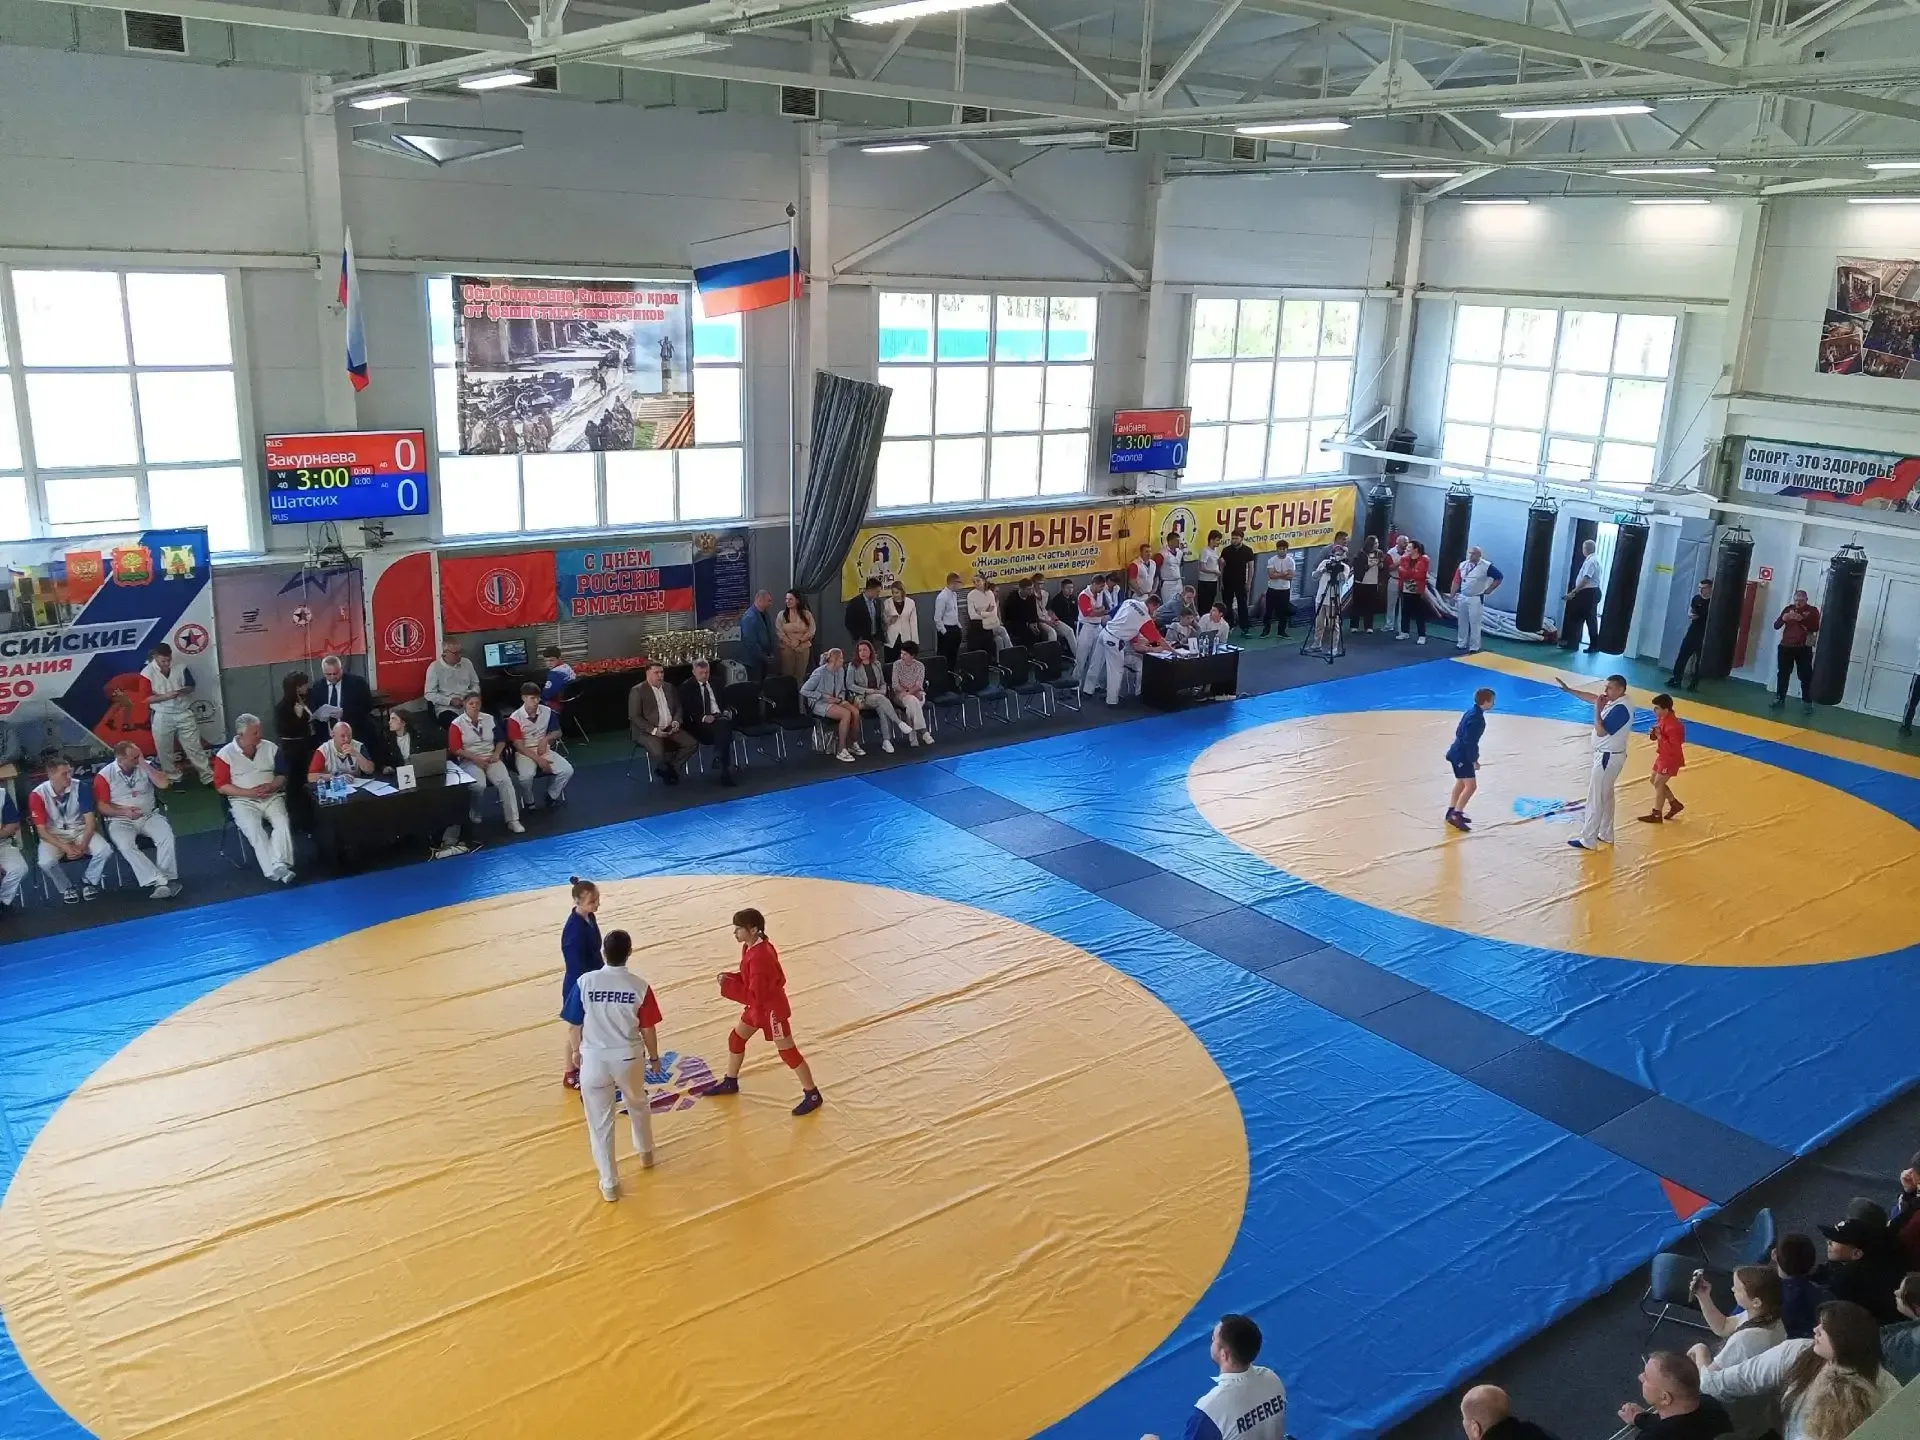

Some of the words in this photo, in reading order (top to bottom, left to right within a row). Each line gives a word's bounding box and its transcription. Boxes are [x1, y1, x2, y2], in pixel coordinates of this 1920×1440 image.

[647, 292, 679, 308] края
[1114, 423, 1147, 433] Тамбиев
[1175, 413, 1186, 437] 0
[266, 440, 283, 448] RUS
[1125, 434, 1152, 450] 3:00
[267, 452, 357, 468] Закурнаева
[395, 438, 416, 471] 0
[1111, 453, 1143, 463] Соколов
[1172, 443, 1184, 466] 0
[1795, 456, 1820, 470] ЭТО
[296, 467, 349, 491] 3:00
[353, 467, 371, 476] 0:00
[354, 477, 371, 485] 0:00
[1744, 467, 1780, 484] ВОЛЯ
[1781, 473, 1791, 486] И
[1792, 475, 1864, 496] МУЖЕСТВО
[271, 494, 338, 509] Шатских
[397, 479, 418, 511] 0
[272, 513, 289, 521] RUS
[1216, 499, 1333, 534] ЧЕСТНЫЕ
[960, 513, 1113, 555] СИЛЬНЫЕ
[583, 553, 596, 571] С
[601, 547, 652, 572] ДНЁМ
[1037, 550, 1070, 560] счастья
[1000, 565, 1037, 577] сильным
[576, 568, 660, 595] РОССИИ
[571, 589, 665, 618] ВМЕСТЕ!
[0, 628, 138, 657] СИЙСКИЕ
[588, 990, 637, 1004] REFEREE
